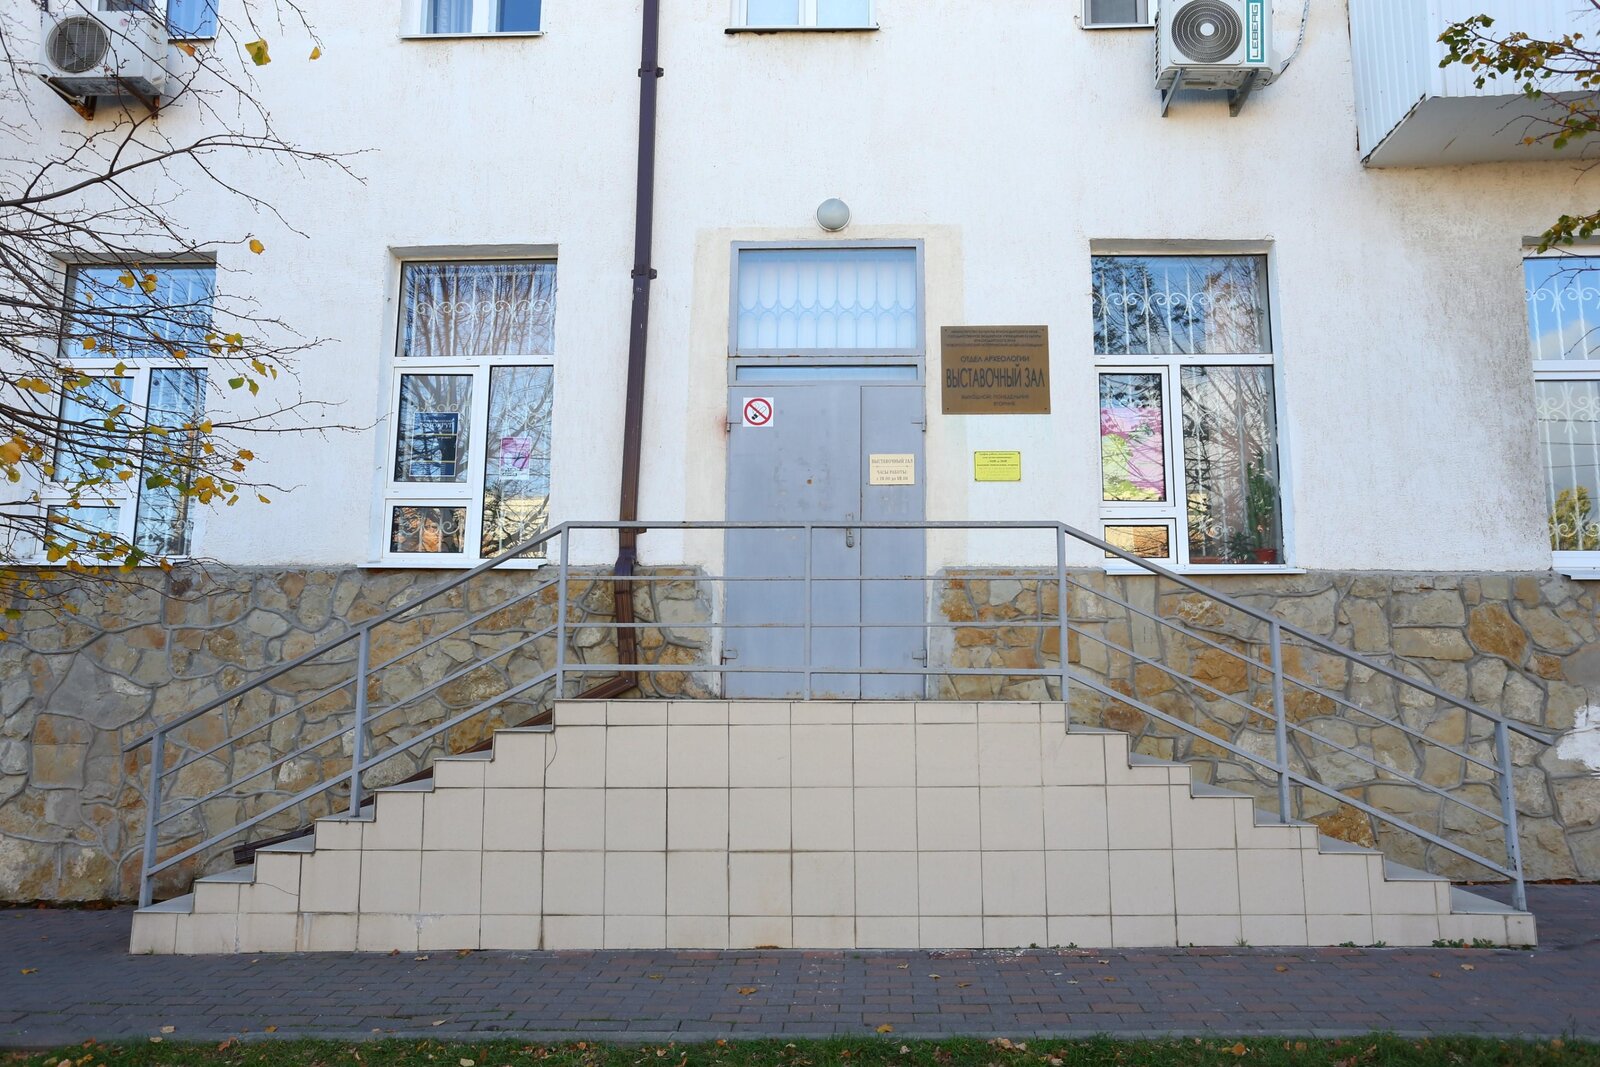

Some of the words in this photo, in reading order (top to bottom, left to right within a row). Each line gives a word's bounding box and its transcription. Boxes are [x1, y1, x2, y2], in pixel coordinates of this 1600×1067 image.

[1251, 4, 1259, 58] LEBERG
[960, 355, 983, 363] ОТДЕЛ
[984, 355, 1030, 363] АРХЕОЛОГИИ
[946, 364, 1022, 388] ВЫСТАВОЧНЫЙ
[1024, 367, 1046, 388] ЗАЛ
